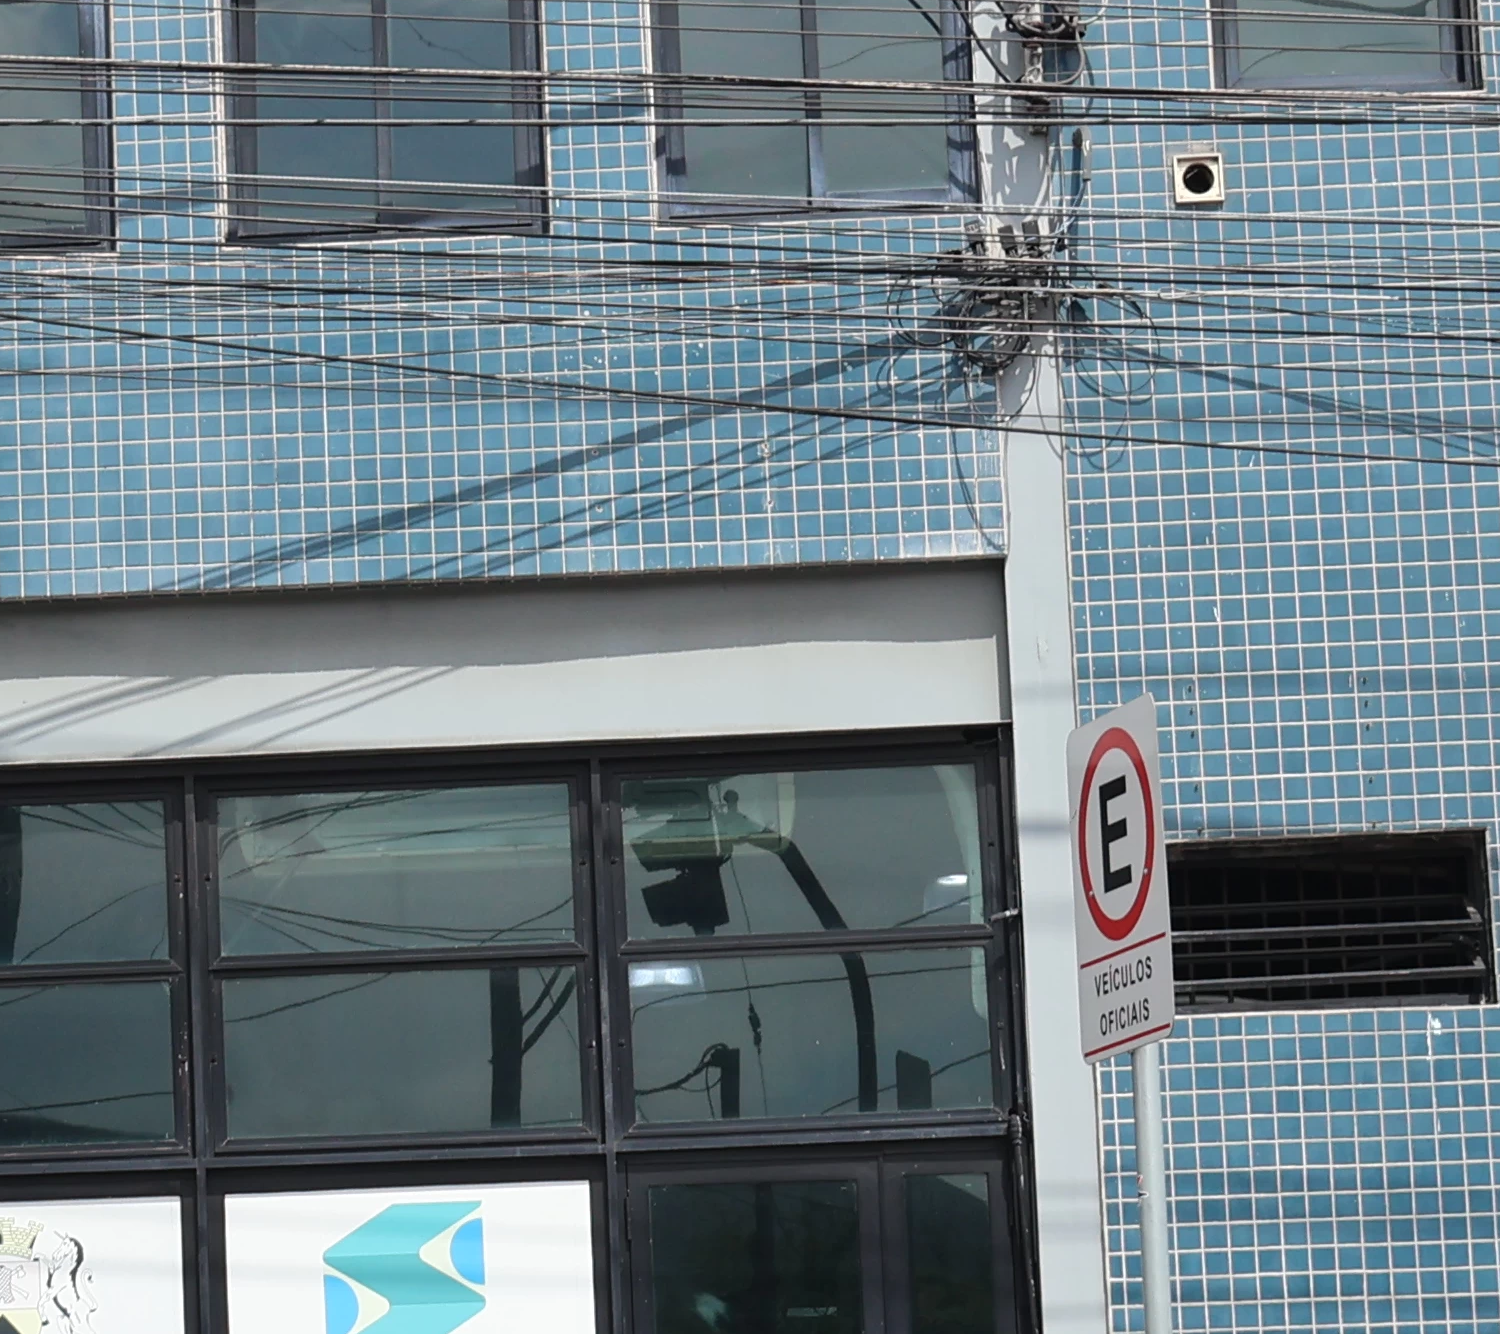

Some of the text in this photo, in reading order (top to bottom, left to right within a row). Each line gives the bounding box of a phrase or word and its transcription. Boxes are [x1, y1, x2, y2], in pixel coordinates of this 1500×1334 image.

[1097, 774, 1133, 894] E
[1094, 955, 1154, 998] VEÍCULOS
[1099, 1006, 1151, 1037] OFICIAIS
